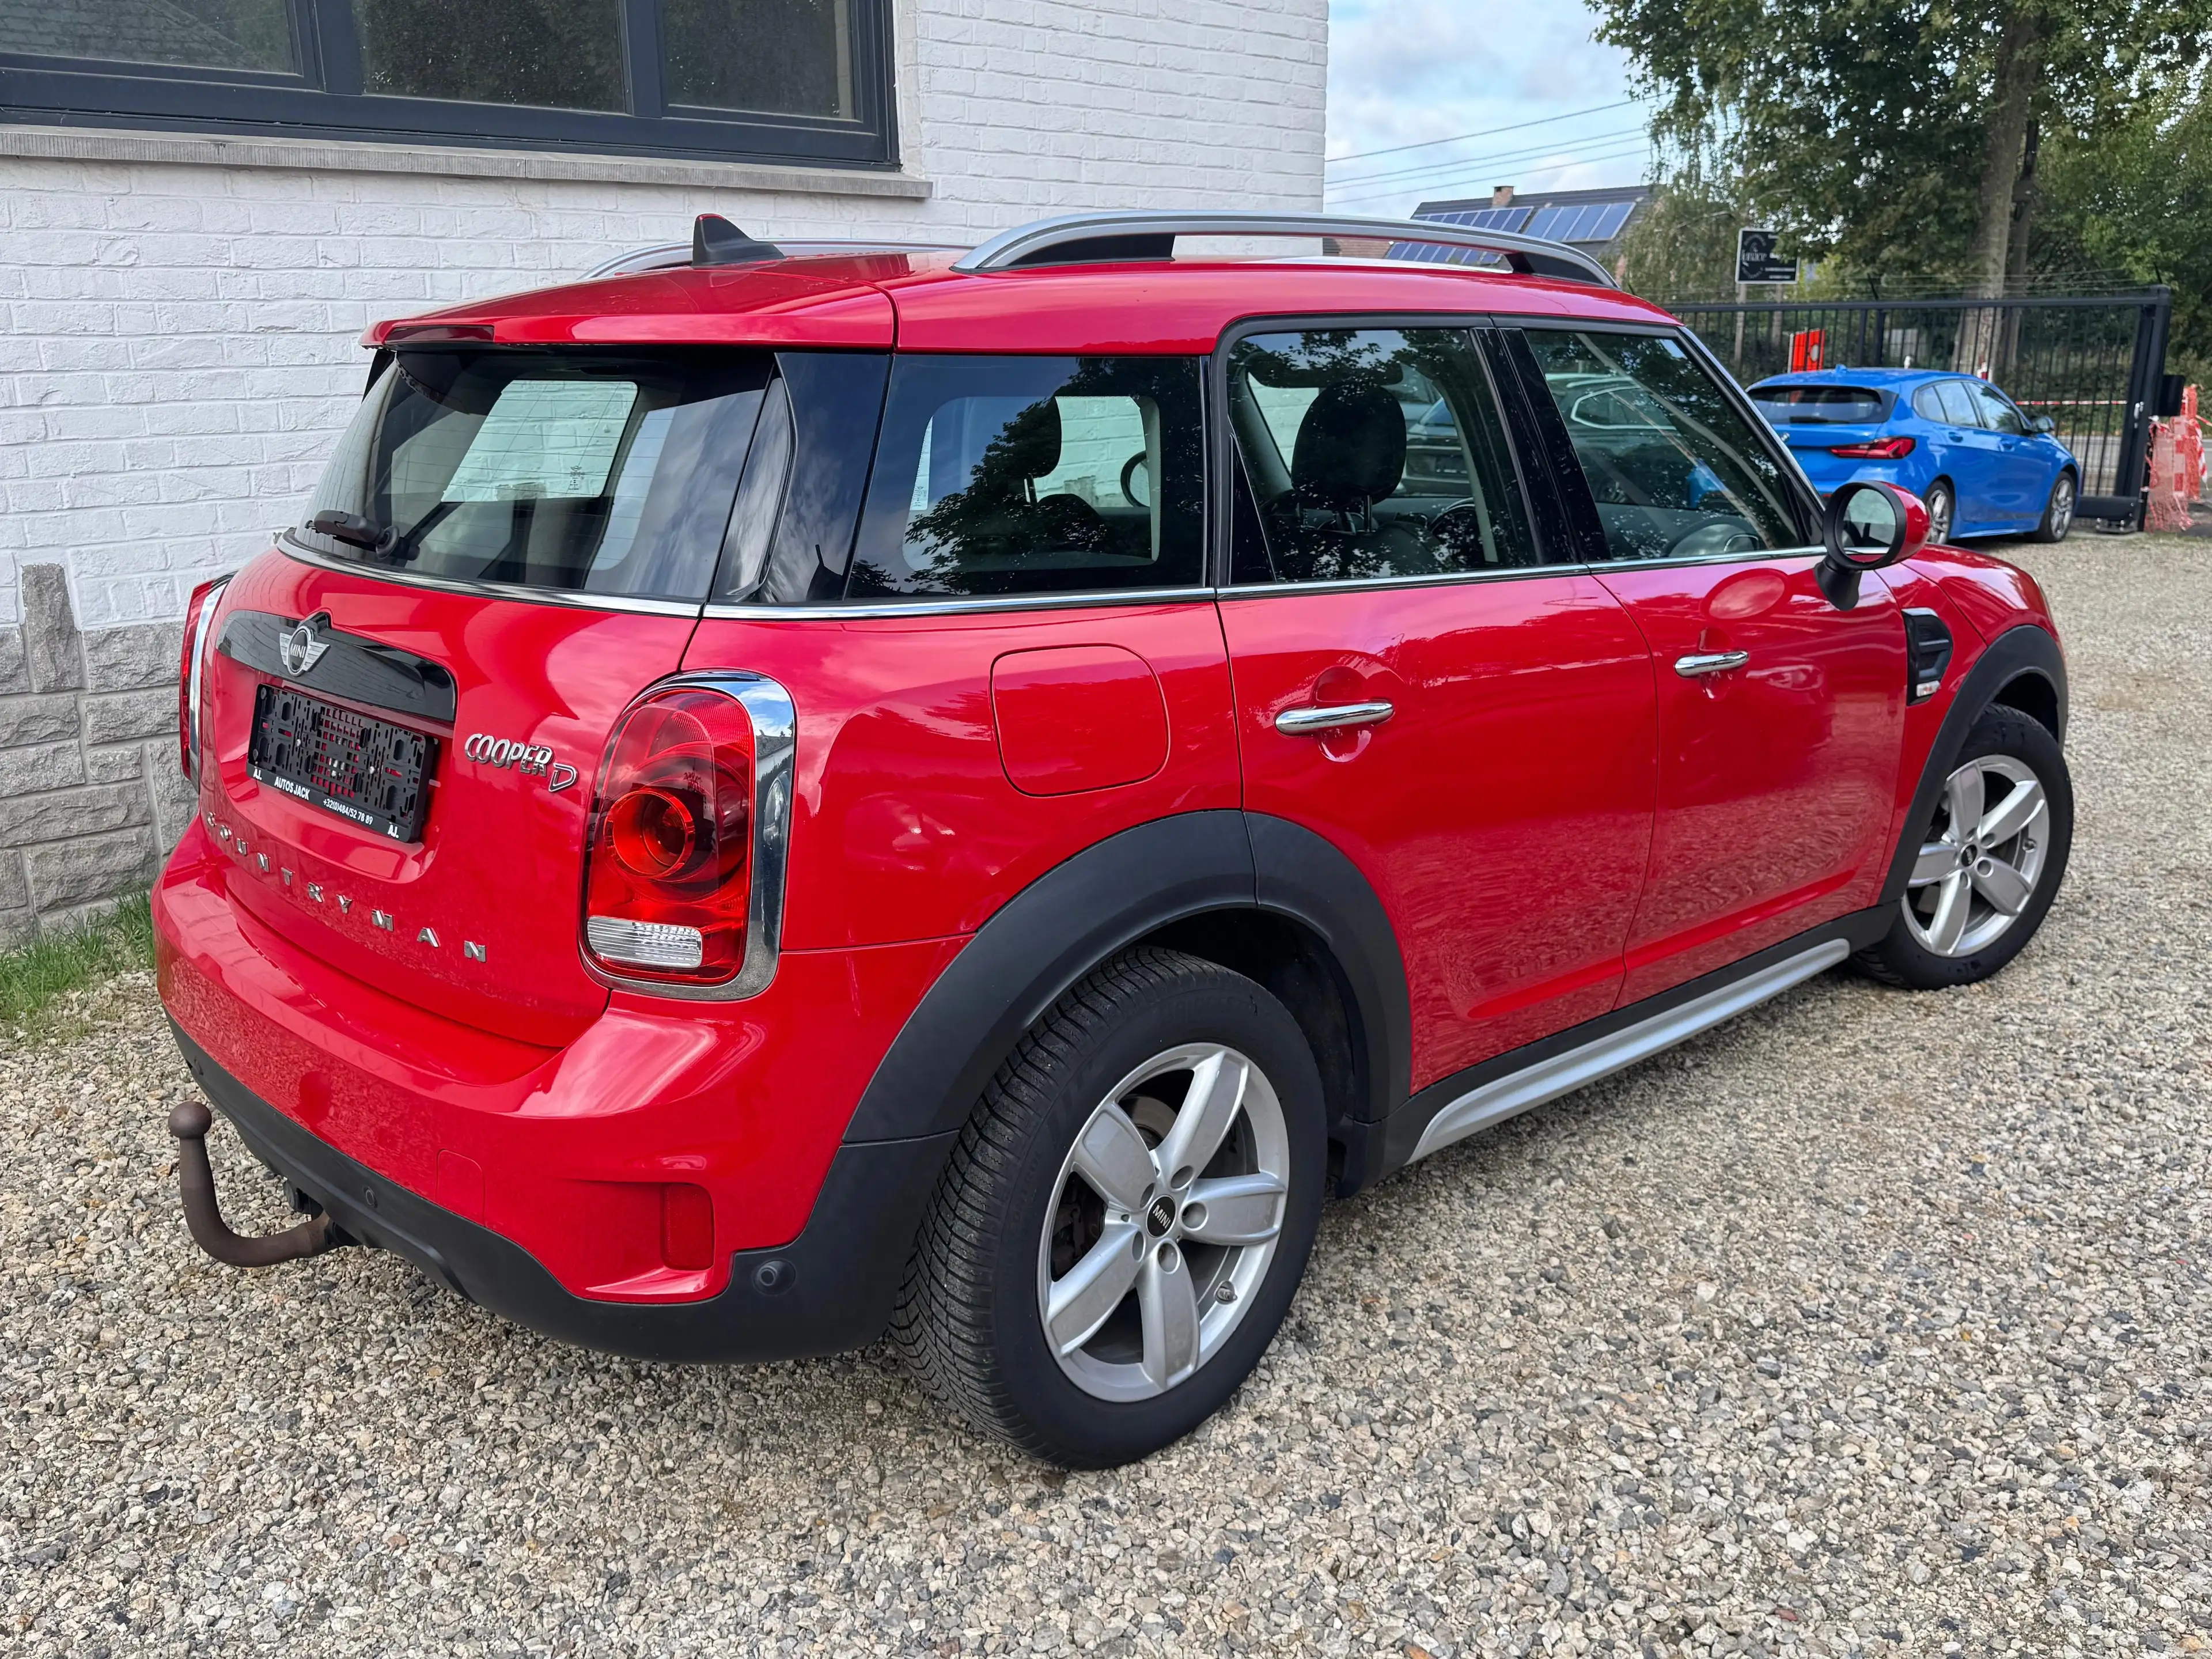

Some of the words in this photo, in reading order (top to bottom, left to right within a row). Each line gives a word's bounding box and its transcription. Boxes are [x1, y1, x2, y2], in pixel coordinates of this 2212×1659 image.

[289, 643, 306, 658] MINI
[464, 733, 553, 777] COOPER
[548, 762, 578, 793] D
[274, 776, 294, 793] AUTOS
[293, 784, 310, 801] JACK
[357, 811, 365, 822] 78
[365, 815, 374, 825] 89
[207, 811, 487, 964] COUNTRYMAN
[1152, 1204, 1171, 1229] MINI
